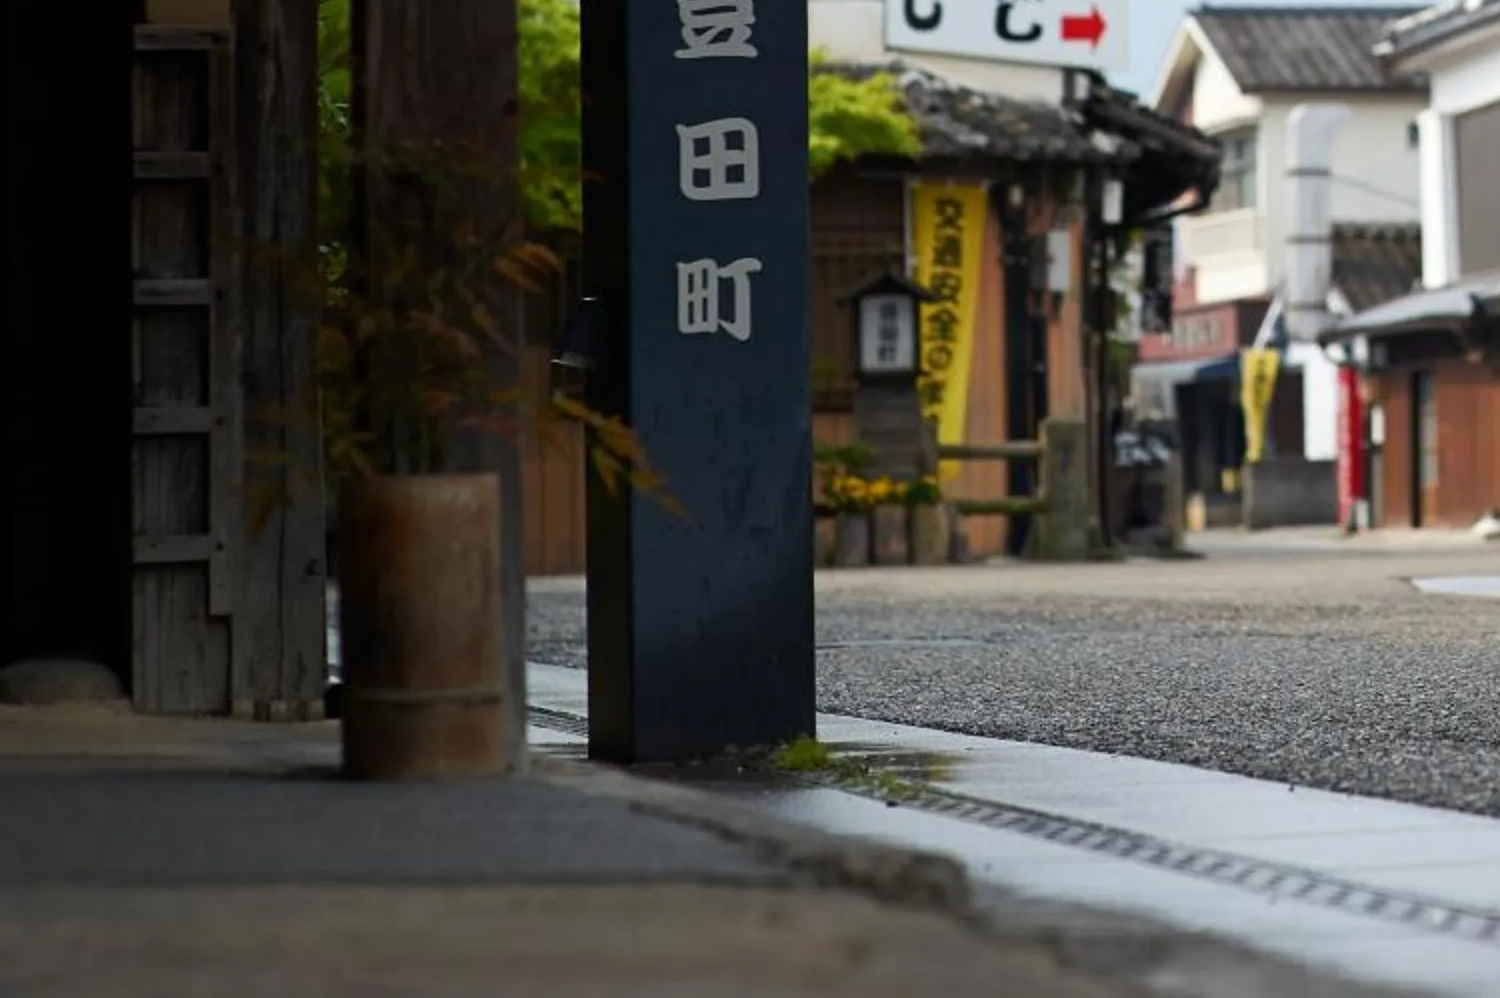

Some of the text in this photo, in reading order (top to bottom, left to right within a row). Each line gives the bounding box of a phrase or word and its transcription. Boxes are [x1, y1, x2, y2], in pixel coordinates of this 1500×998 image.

[919, 199, 963, 420] 交通安全の
